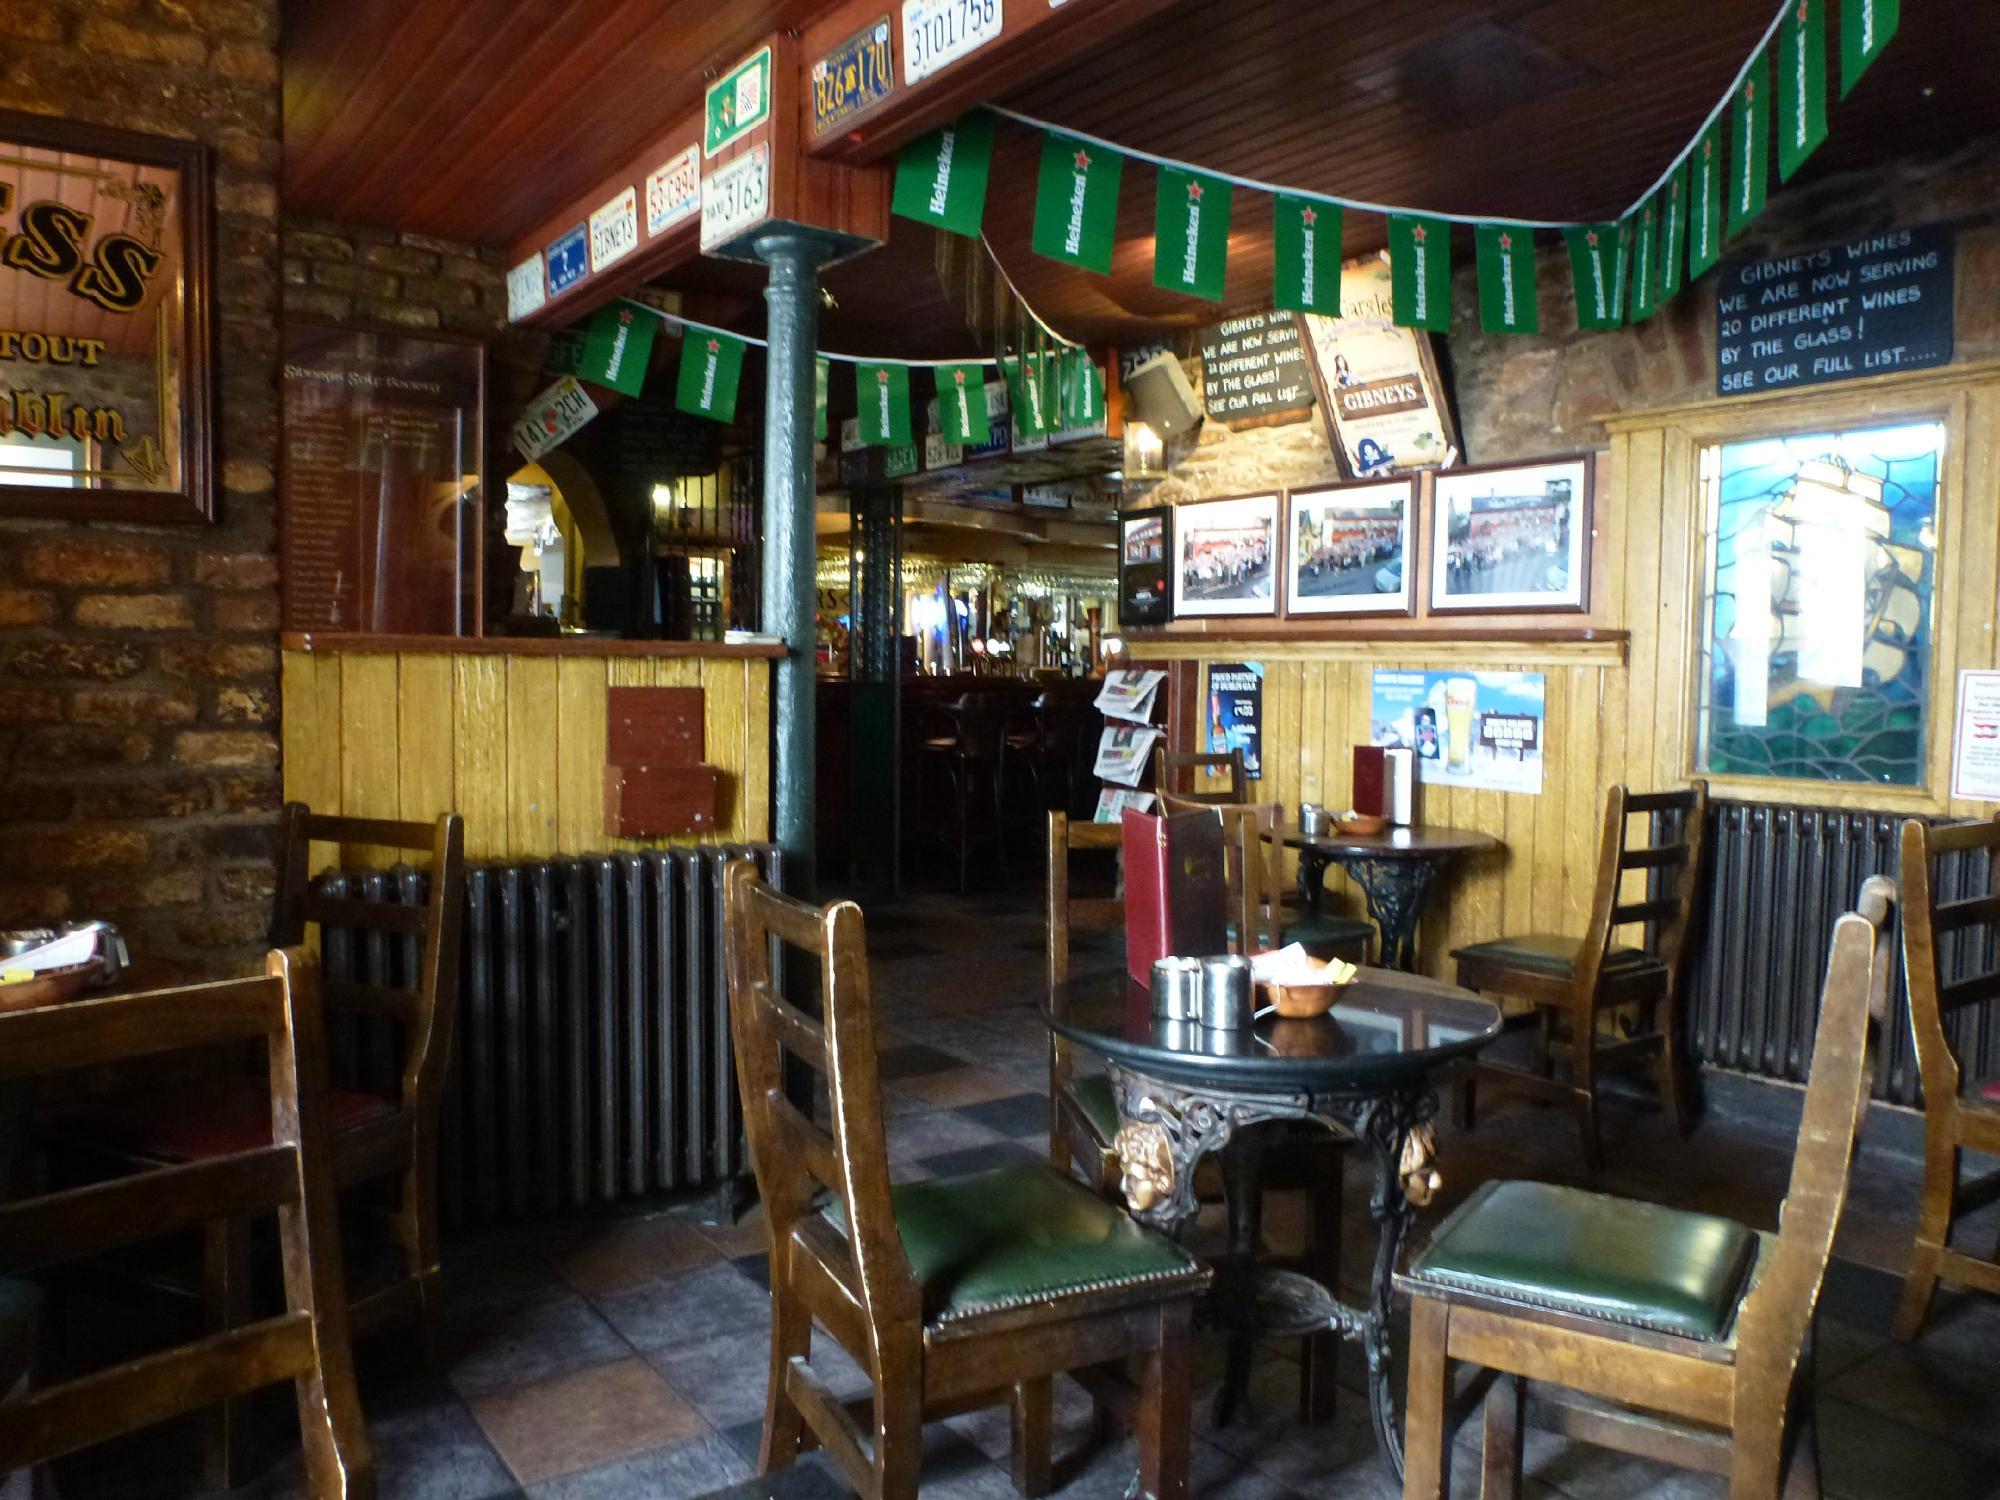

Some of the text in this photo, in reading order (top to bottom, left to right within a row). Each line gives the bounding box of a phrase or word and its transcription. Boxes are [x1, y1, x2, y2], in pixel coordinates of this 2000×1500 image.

[929, 131, 955, 216] Heineken
[1065, 173, 1087, 256] Heineken
[0, 184, 165, 313] SS
[1182, 204, 1200, 285] Heineken
[1301, 229, 1314, 305] Heineken
[1740, 230, 1911, 285] GIBNEYS WINES
[1416, 246, 1426, 321] Heineken
[1502, 253, 1514, 325] Heineken
[1720, 251, 1938, 314] WE ARE NOW SERVING
[1220, 315, 1264, 337] GIBNEYS
[1721, 285, 1921, 338] 20 DIFFERENT WINES
[604, 324, 628, 382] Heineken
[1203, 346, 1216, 360] WE
[1220, 341, 1238, 356] ARE
[1243, 333, 1262, 350] NOW
[1219, 353, 1270, 375] DIFFERENT
[1721, 345, 1741, 365] BY
[1751, 339, 1783, 358] THE
[1721, 370, 1754, 392] SEE
[1764, 363, 1799, 384] OUR
[1813, 356, 1853, 375] FULL
[700, 353, 717, 411] Heineken
[1206, 381, 1218, 396] BY
[1223, 377, 1241, 392] THE
[1208, 399, 1226, 414] SEE
[1228, 395, 1248, 410] OUR
[1252, 392, 1272, 407] FULL
[1343, 382, 1417, 411] GIBNEYS
